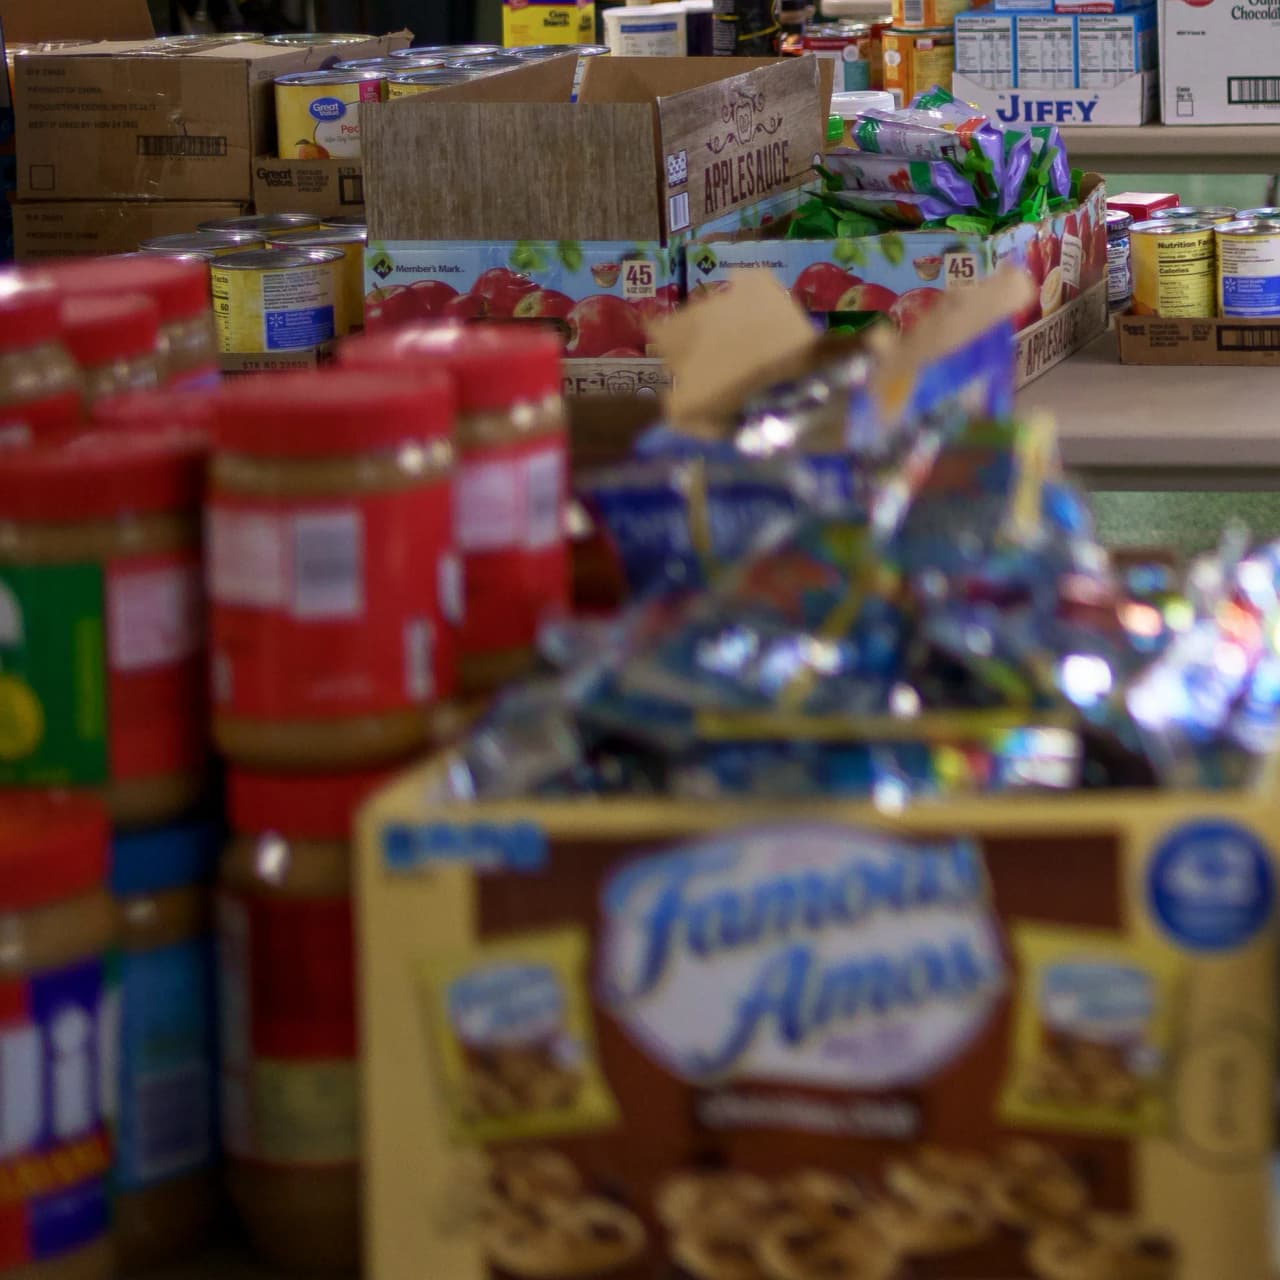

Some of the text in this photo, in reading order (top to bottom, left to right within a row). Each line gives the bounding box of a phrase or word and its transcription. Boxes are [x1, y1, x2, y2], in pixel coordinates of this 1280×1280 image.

[313, 103, 338, 111] Great
[256, 168, 291, 179] Great
[703, 140, 791, 214] APPLESAUCE
[1157, 241, 1196, 249] Nutrition
[395, 264, 437, 273] Member's
[719, 260, 761, 269] Member's
[948, 257, 974, 279] 45
[626, 265, 652, 286] 45
[1159, 267, 1189, 275] Calories
[606, 836, 982, 996] Famous
[690, 932, 982, 1078] Amos
